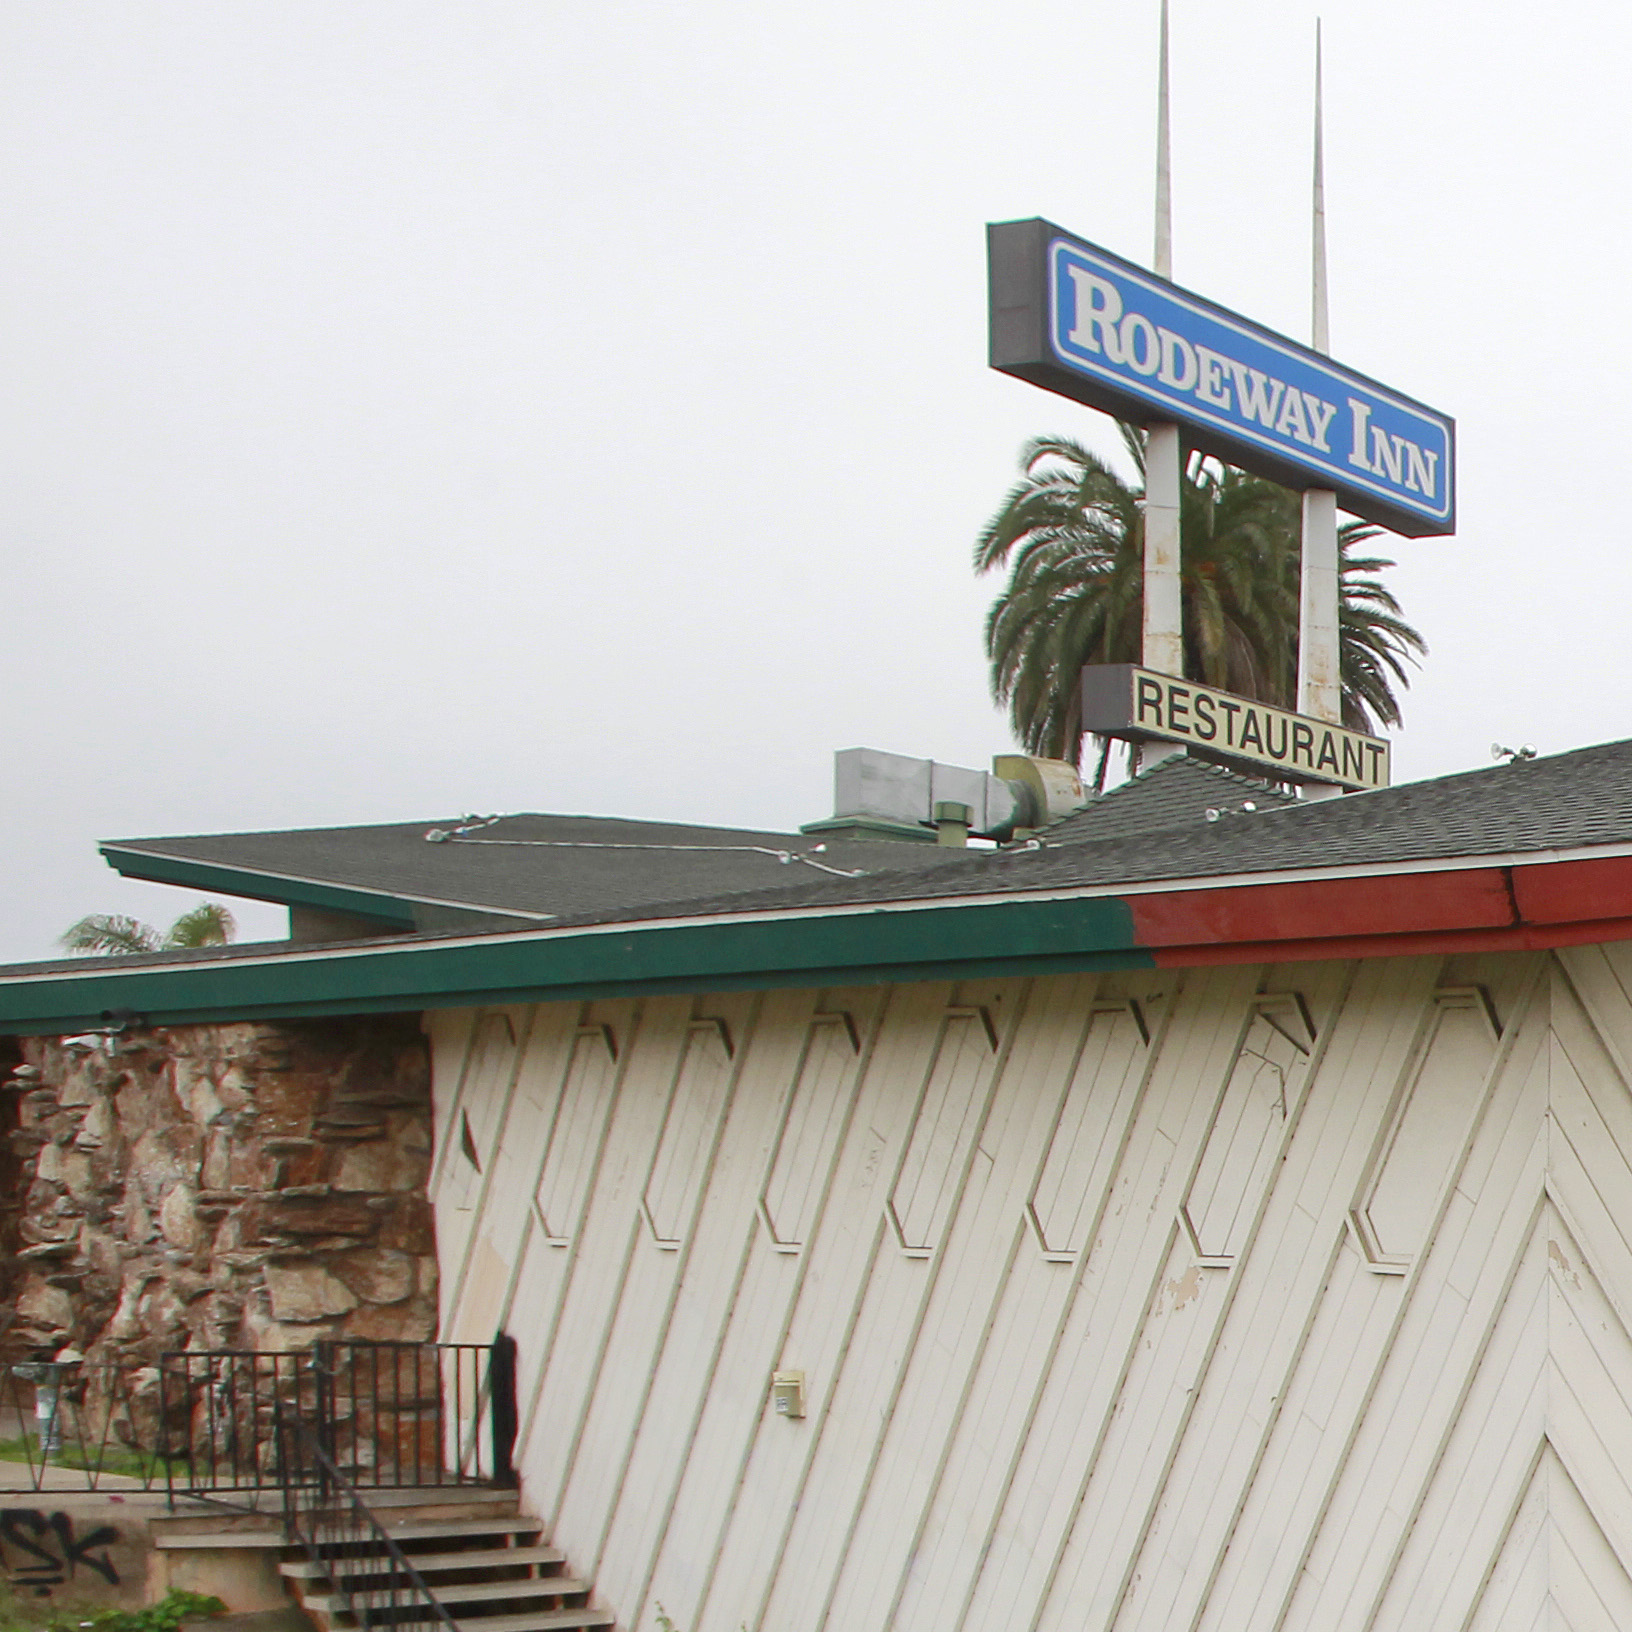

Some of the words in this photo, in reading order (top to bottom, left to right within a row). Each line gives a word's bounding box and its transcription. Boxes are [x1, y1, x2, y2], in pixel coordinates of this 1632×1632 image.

[1066, 264, 1337, 453] RODEWAY
[1347, 397, 1439, 499] INN
[1137, 678, 1386, 785] RESTAURANT
